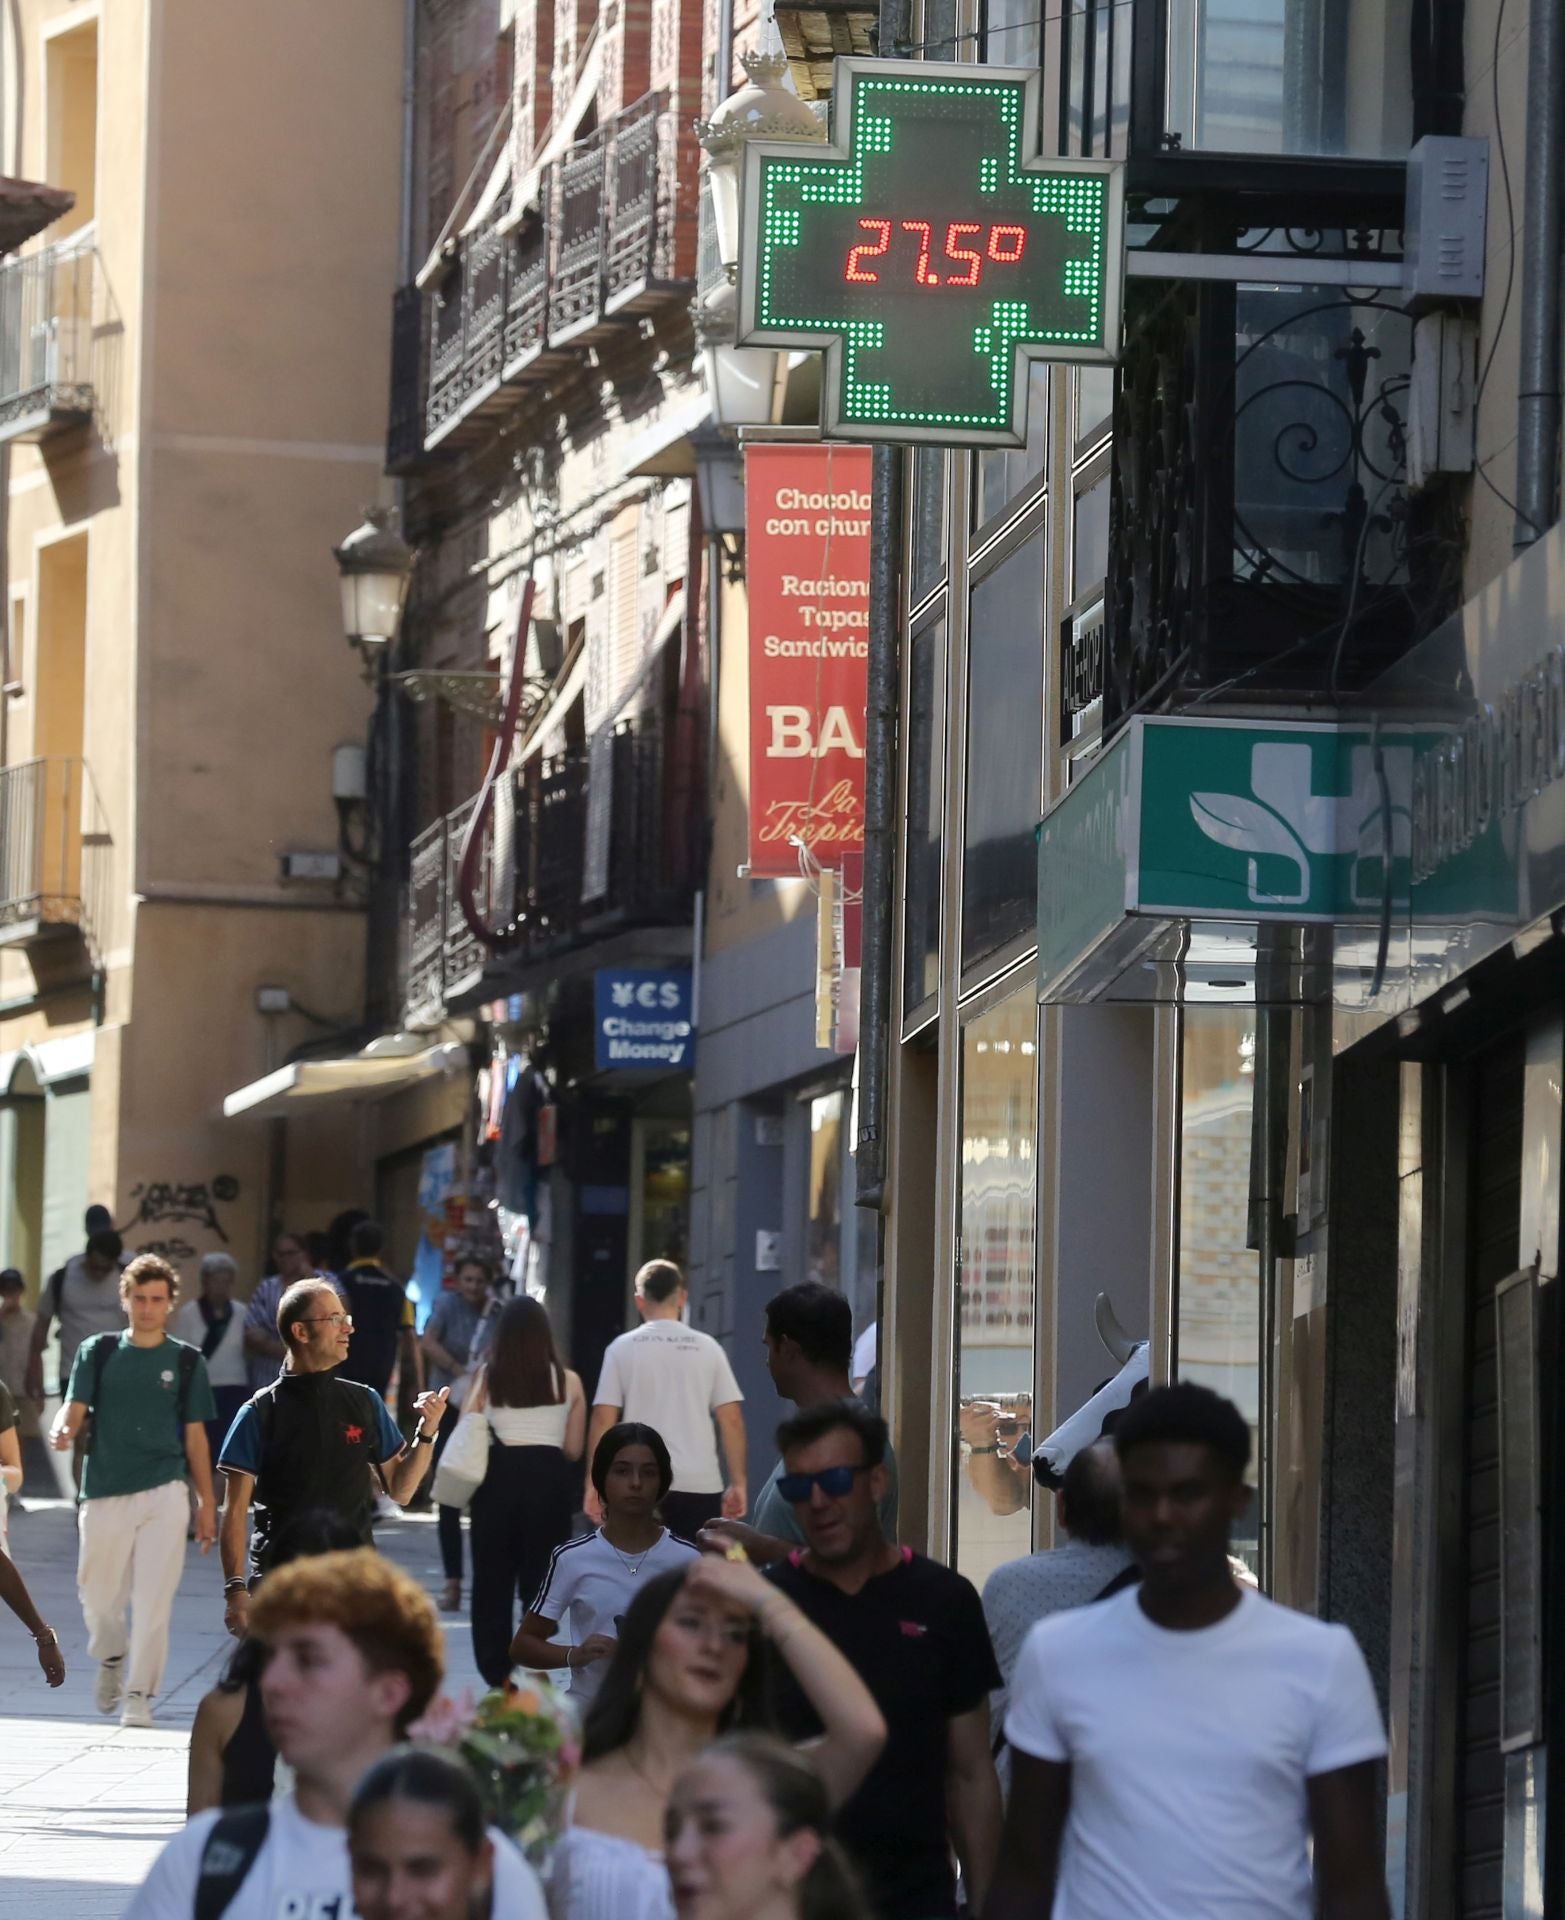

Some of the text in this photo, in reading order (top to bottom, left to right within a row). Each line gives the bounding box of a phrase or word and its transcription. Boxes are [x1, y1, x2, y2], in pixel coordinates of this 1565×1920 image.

[765, 518, 810, 535] con
[765, 705, 867, 759] BA
[798, 778, 858, 820] La
[602, 1016, 691, 1041] Change
[608, 1040, 686, 1063] Money
